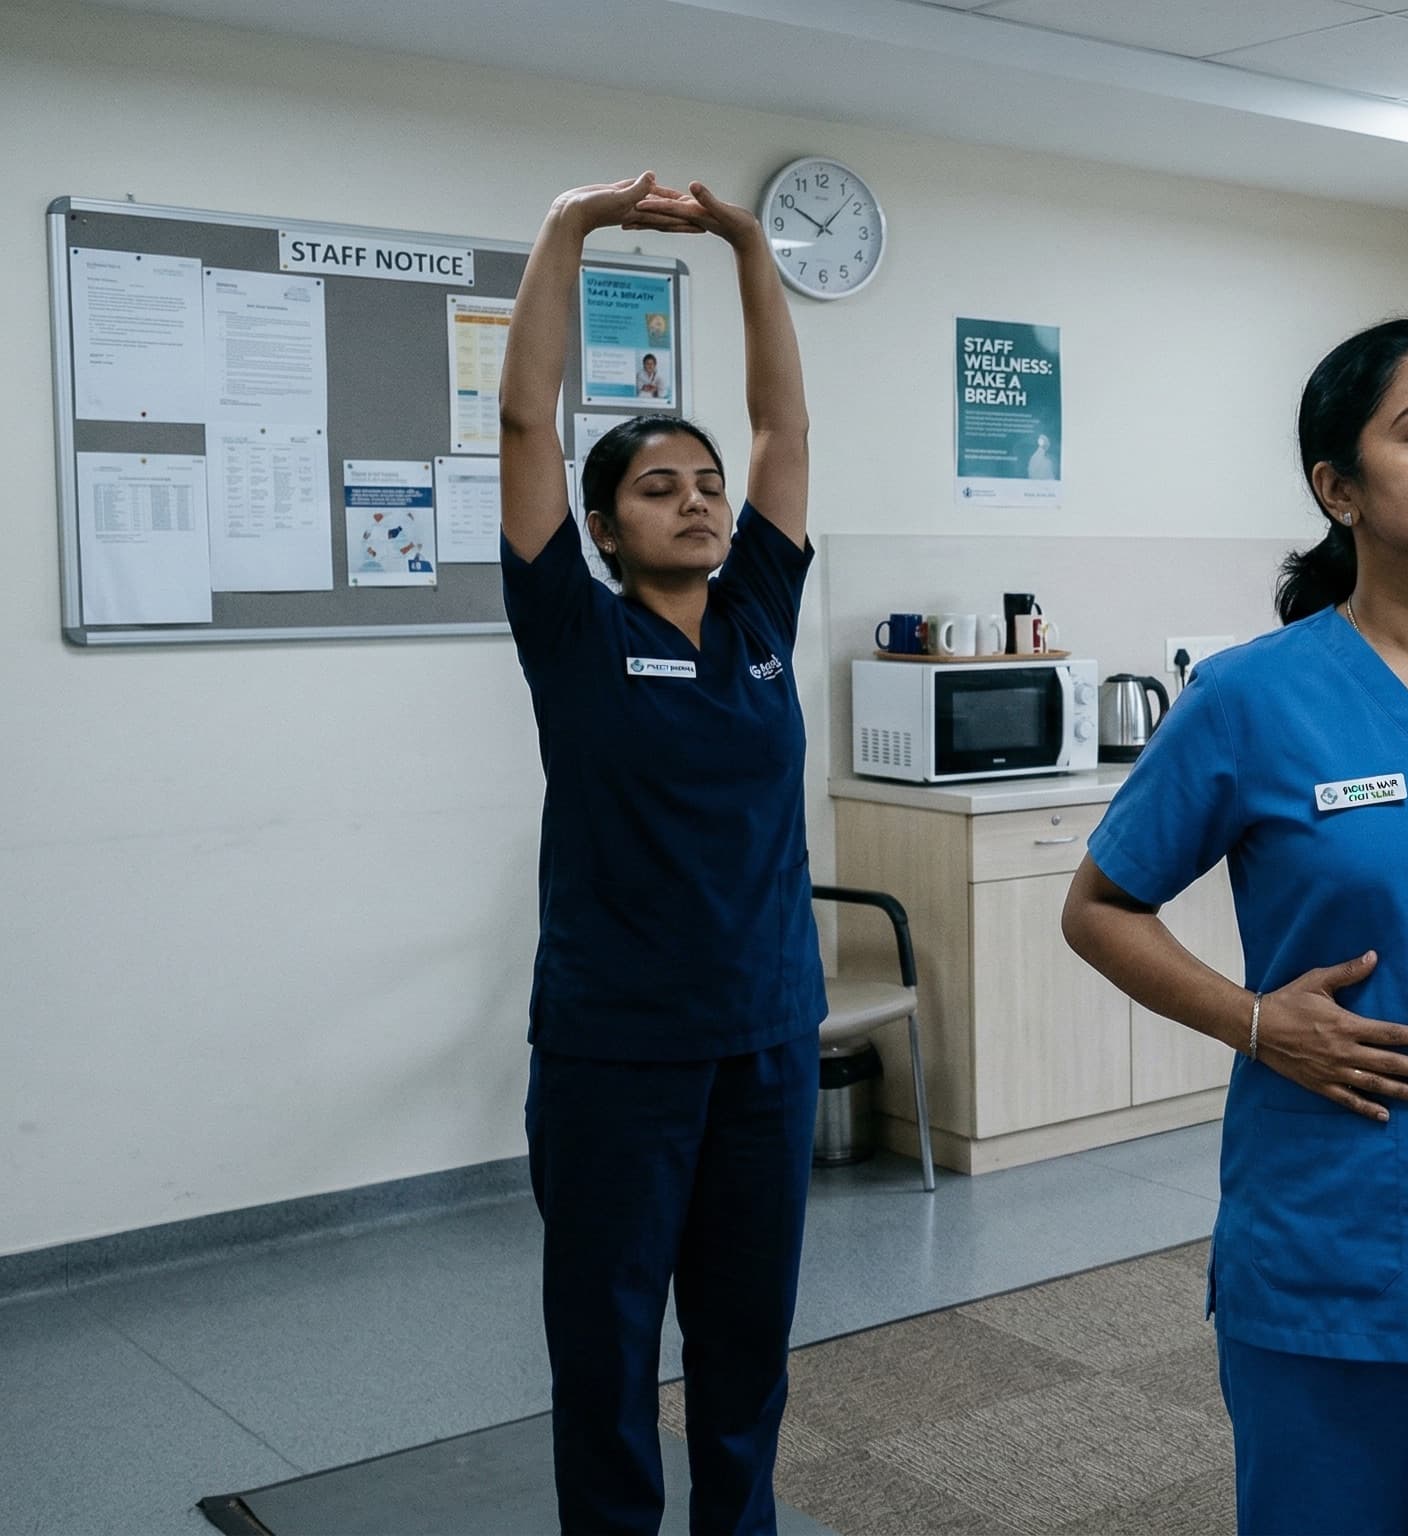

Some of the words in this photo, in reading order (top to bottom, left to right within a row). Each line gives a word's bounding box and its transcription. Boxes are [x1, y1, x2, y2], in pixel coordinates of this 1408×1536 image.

[795, 178, 807, 192] 11
[815, 174, 829, 189] 12
[840, 183, 845, 196] 1
[779, 194, 795, 209] 10
[853, 202, 862, 216] 2
[774, 217, 784, 231] 9
[858, 226, 869, 240] 3
[291, 241, 366, 267] STAFF
[376, 249, 463, 276] NOTICE
[854, 250, 863, 262] 4
[798, 262, 807, 275] 7
[840, 265, 849, 279] 5
[819, 269, 828, 284] 6
[964, 337, 1013, 355] STAFF
[964, 353, 1053, 375] WELLNESS:
[964, 370, 1006, 388] TAKE
[1008, 375, 1021, 389] A
[965, 388, 1027, 406] BREATH
